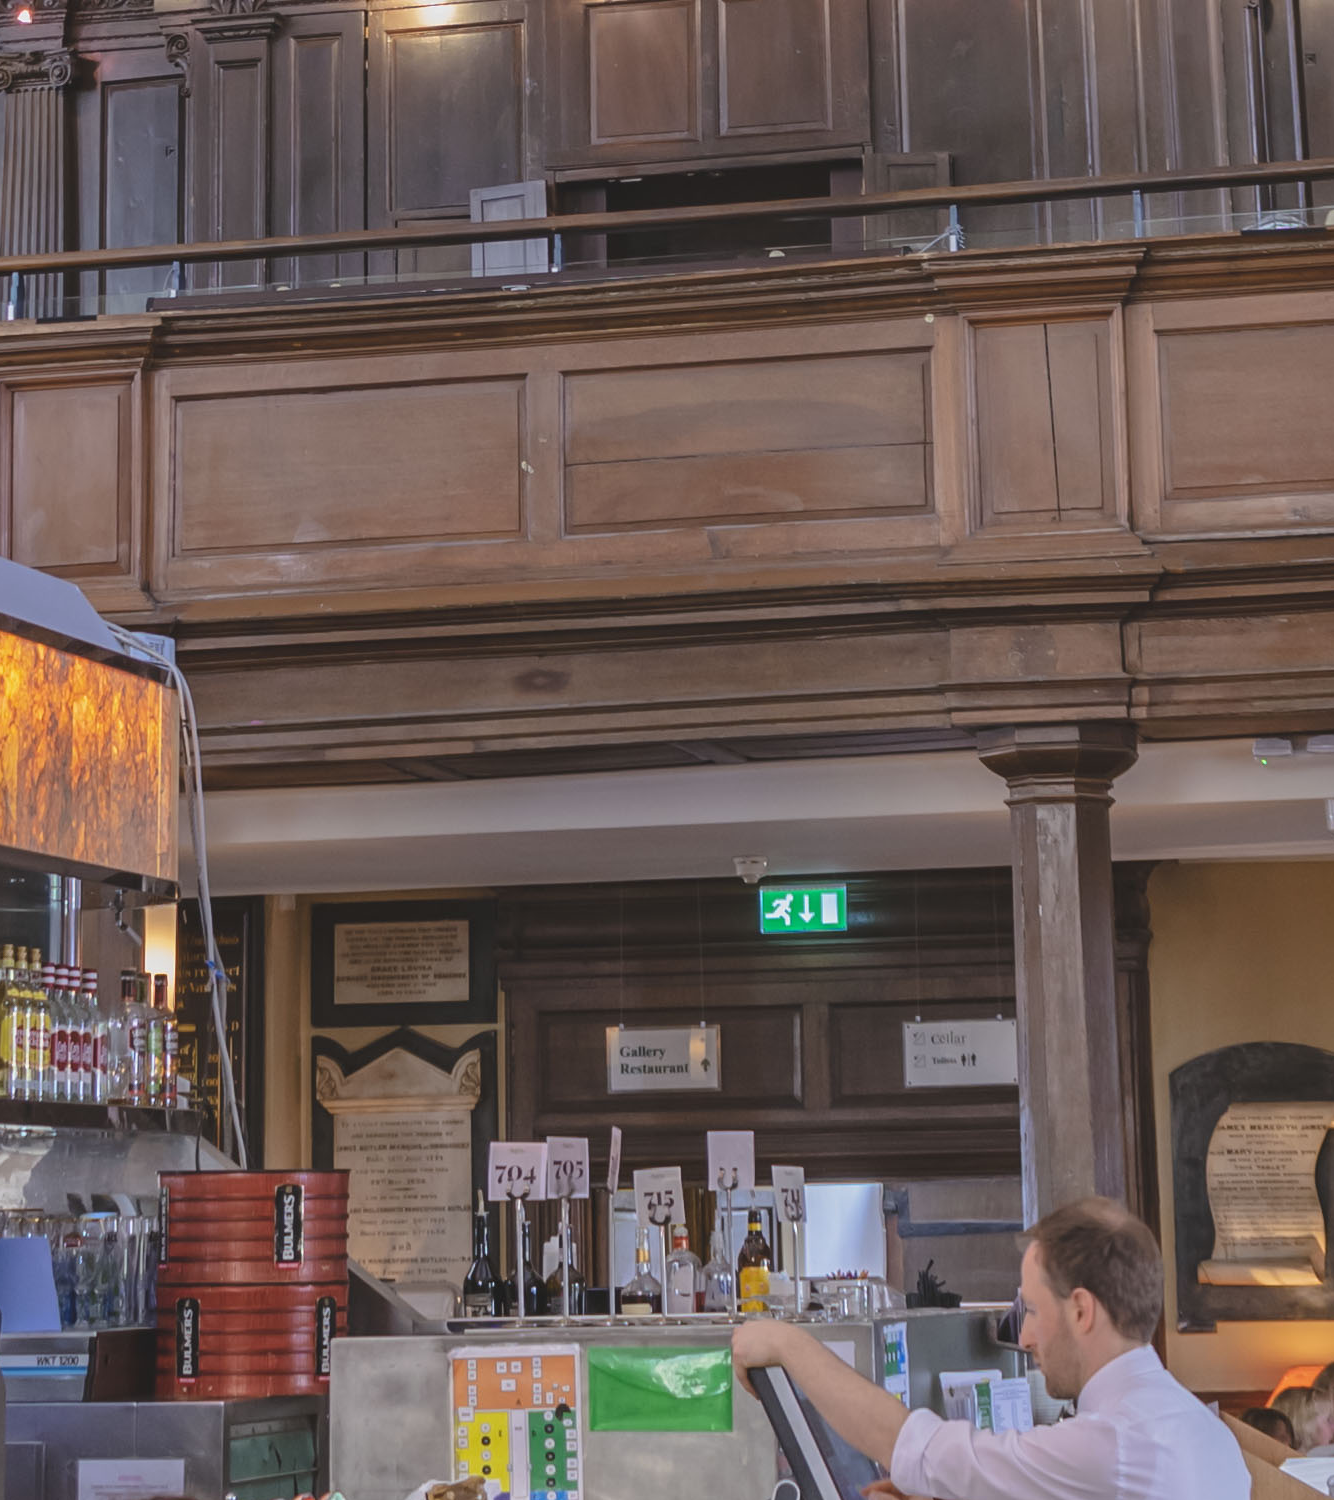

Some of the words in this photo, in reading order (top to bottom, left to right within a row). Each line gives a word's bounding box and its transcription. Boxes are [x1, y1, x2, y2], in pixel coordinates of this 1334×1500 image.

[931, 1030, 966, 1045] Cellar
[619, 1045, 666, 1060] Gallery
[620, 1062, 689, 1075] Restaurant
[495, 1165, 537, 1184] 704
[553, 1160, 584, 1180] 705
[282, 1194, 295, 1261] BULMERS
[182, 1308, 193, 1375] BULMERS
[321, 1306, 331, 1374] BULMERS
[36, 1356, 56, 1366] WKT
[59, 1355, 79, 1366] 1200
